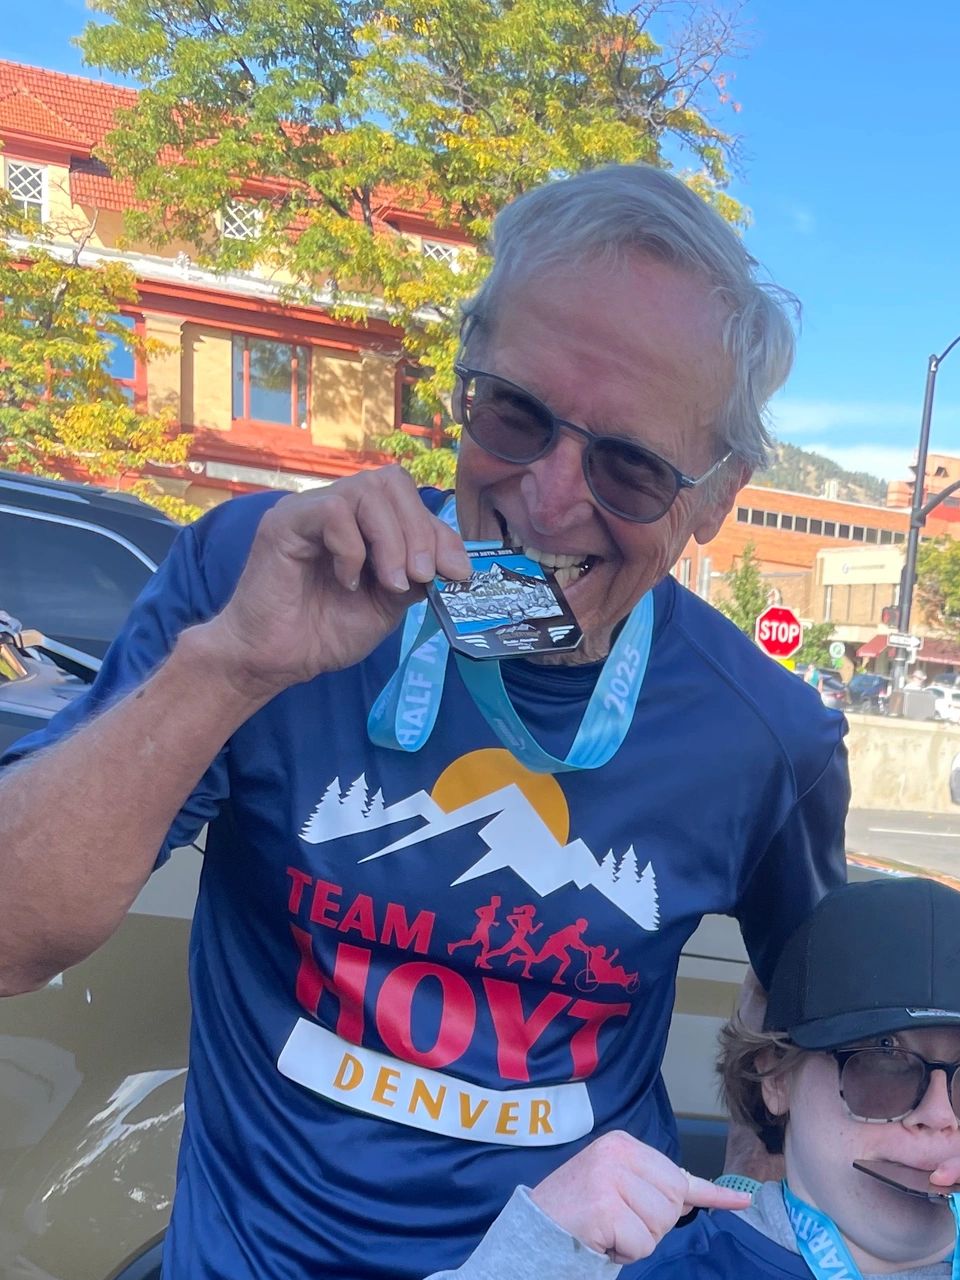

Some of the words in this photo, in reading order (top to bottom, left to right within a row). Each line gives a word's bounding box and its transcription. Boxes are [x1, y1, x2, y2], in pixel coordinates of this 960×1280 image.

[760, 620, 800, 644] STOP
[400, 670, 432, 745] HALF
[604, 645, 640, 715] 2025
[287, 866, 436, 954] TEAM
[290, 922, 631, 1082] HOYT
[333, 1053, 554, 1136] DENVER
